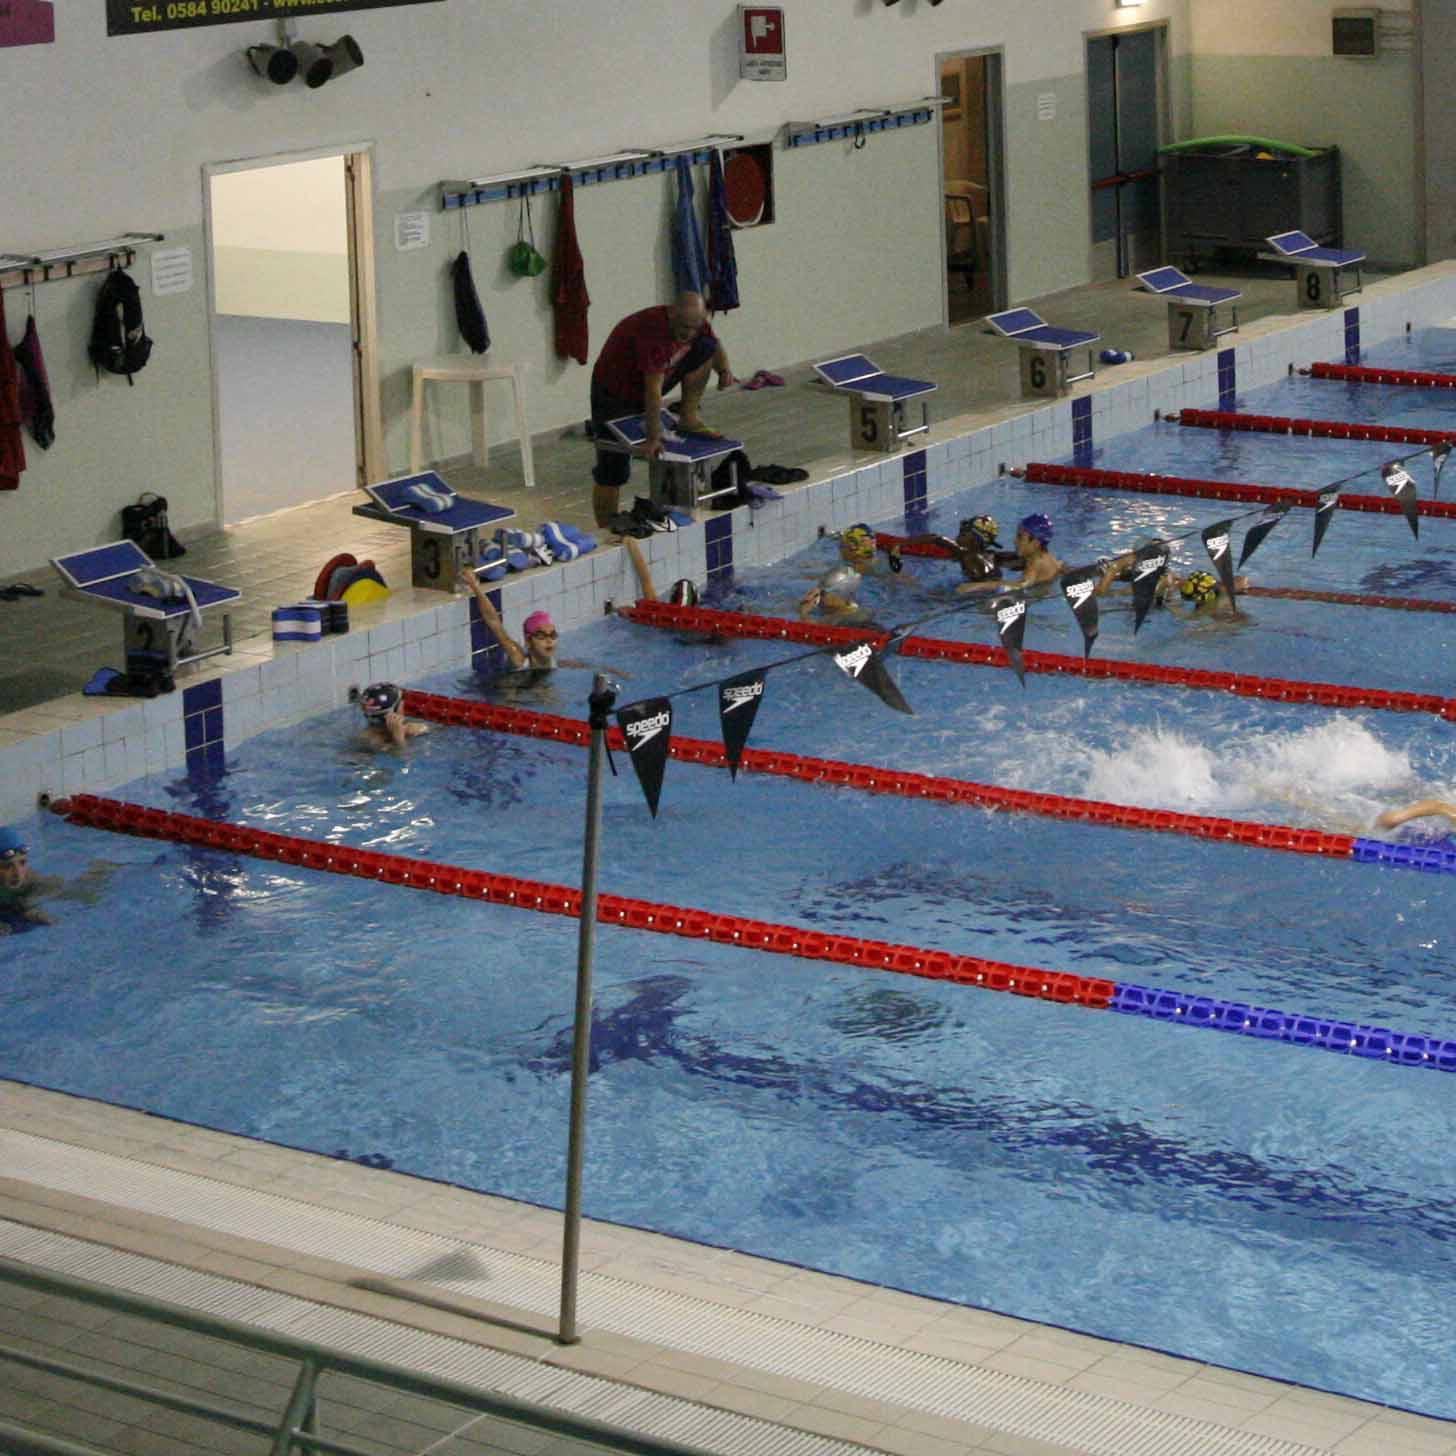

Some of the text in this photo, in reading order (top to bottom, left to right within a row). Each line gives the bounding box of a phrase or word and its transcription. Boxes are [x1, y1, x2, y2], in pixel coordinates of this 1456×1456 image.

[131, 7, 161, 23] Tel.
[166, 0, 208, 20] 0584
[1307, 271, 1321, 302] 8
[1178, 311, 1194, 343] 7
[1029, 357, 1046, 390] 6
[858, 406, 879, 444] 5
[423, 537, 441, 580] 3
[723, 681, 764, 701] speedo
[626, 711, 671, 738] speedo
